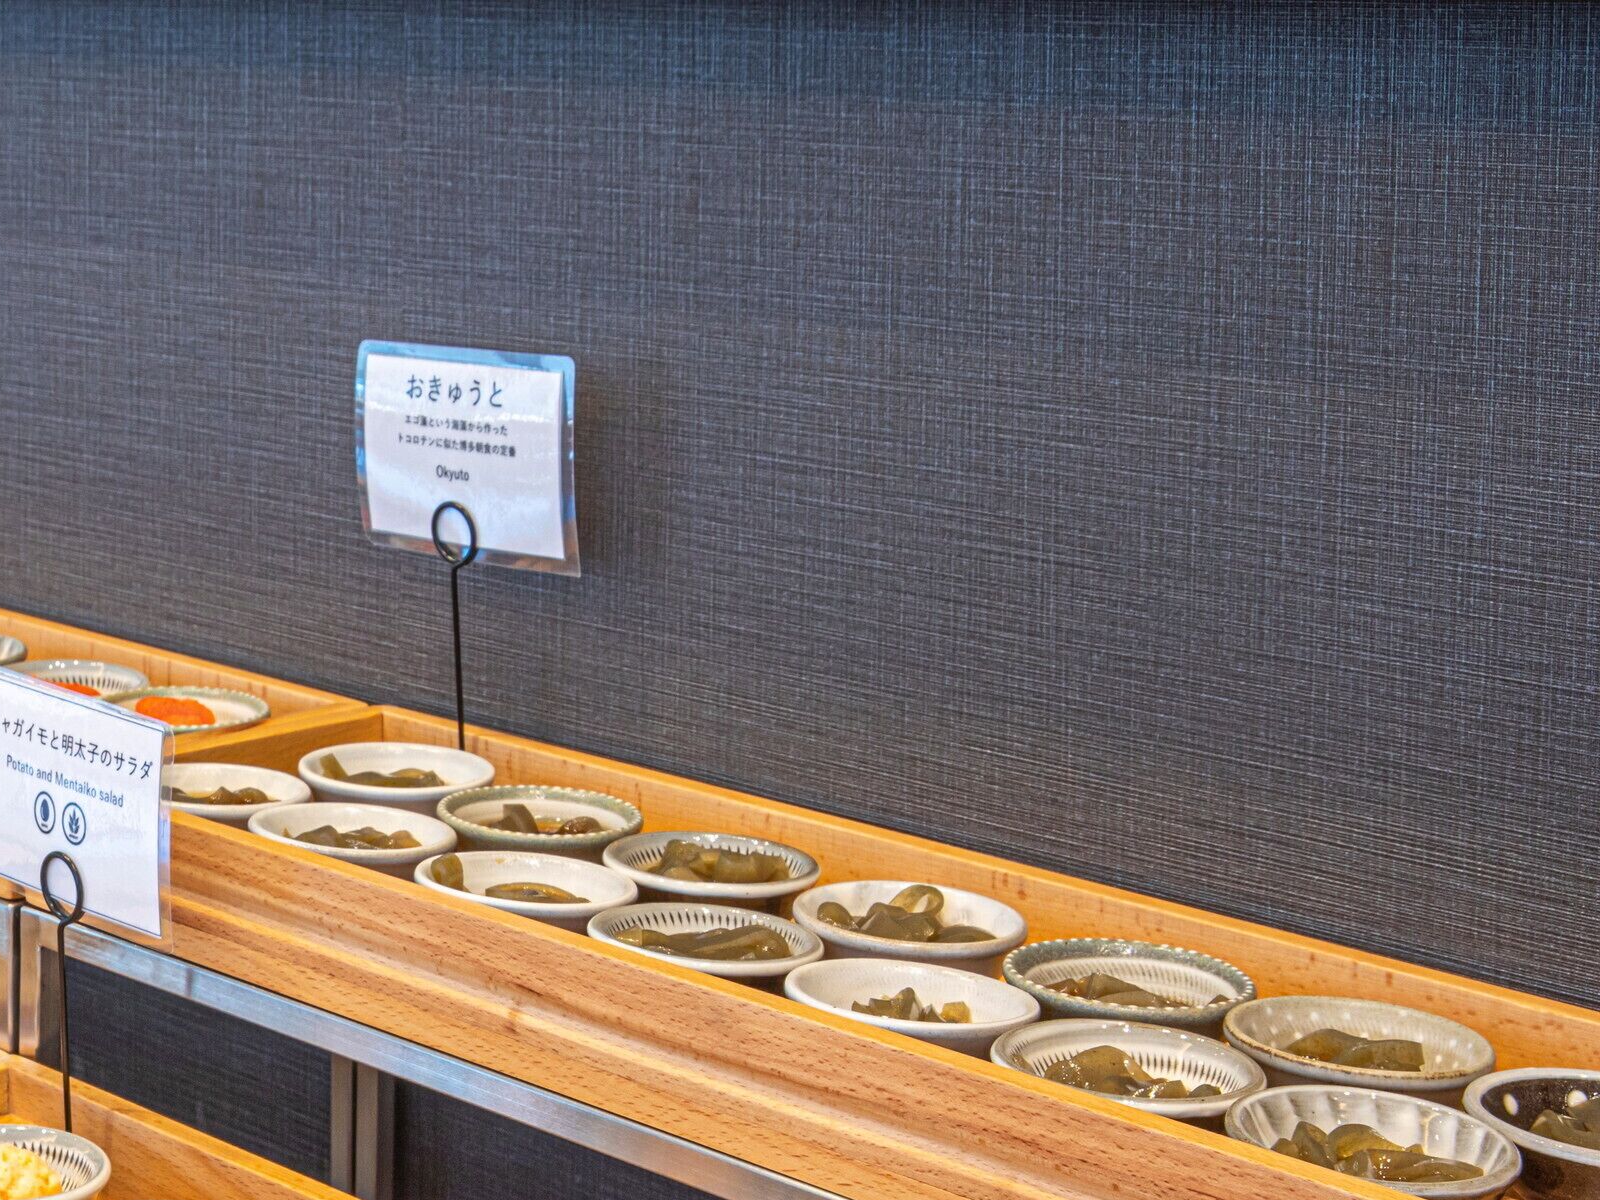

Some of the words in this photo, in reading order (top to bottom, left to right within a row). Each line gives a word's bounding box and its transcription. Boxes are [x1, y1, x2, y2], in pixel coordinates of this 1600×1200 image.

[405, 374, 504, 408] おきゅうと
[435, 464, 470, 482] Okyuto
[6, 754, 34, 776] Potato
[36, 768, 53, 783] and
[54, 771, 97, 799] Mentaiko
[99, 790, 124, 808] salad
